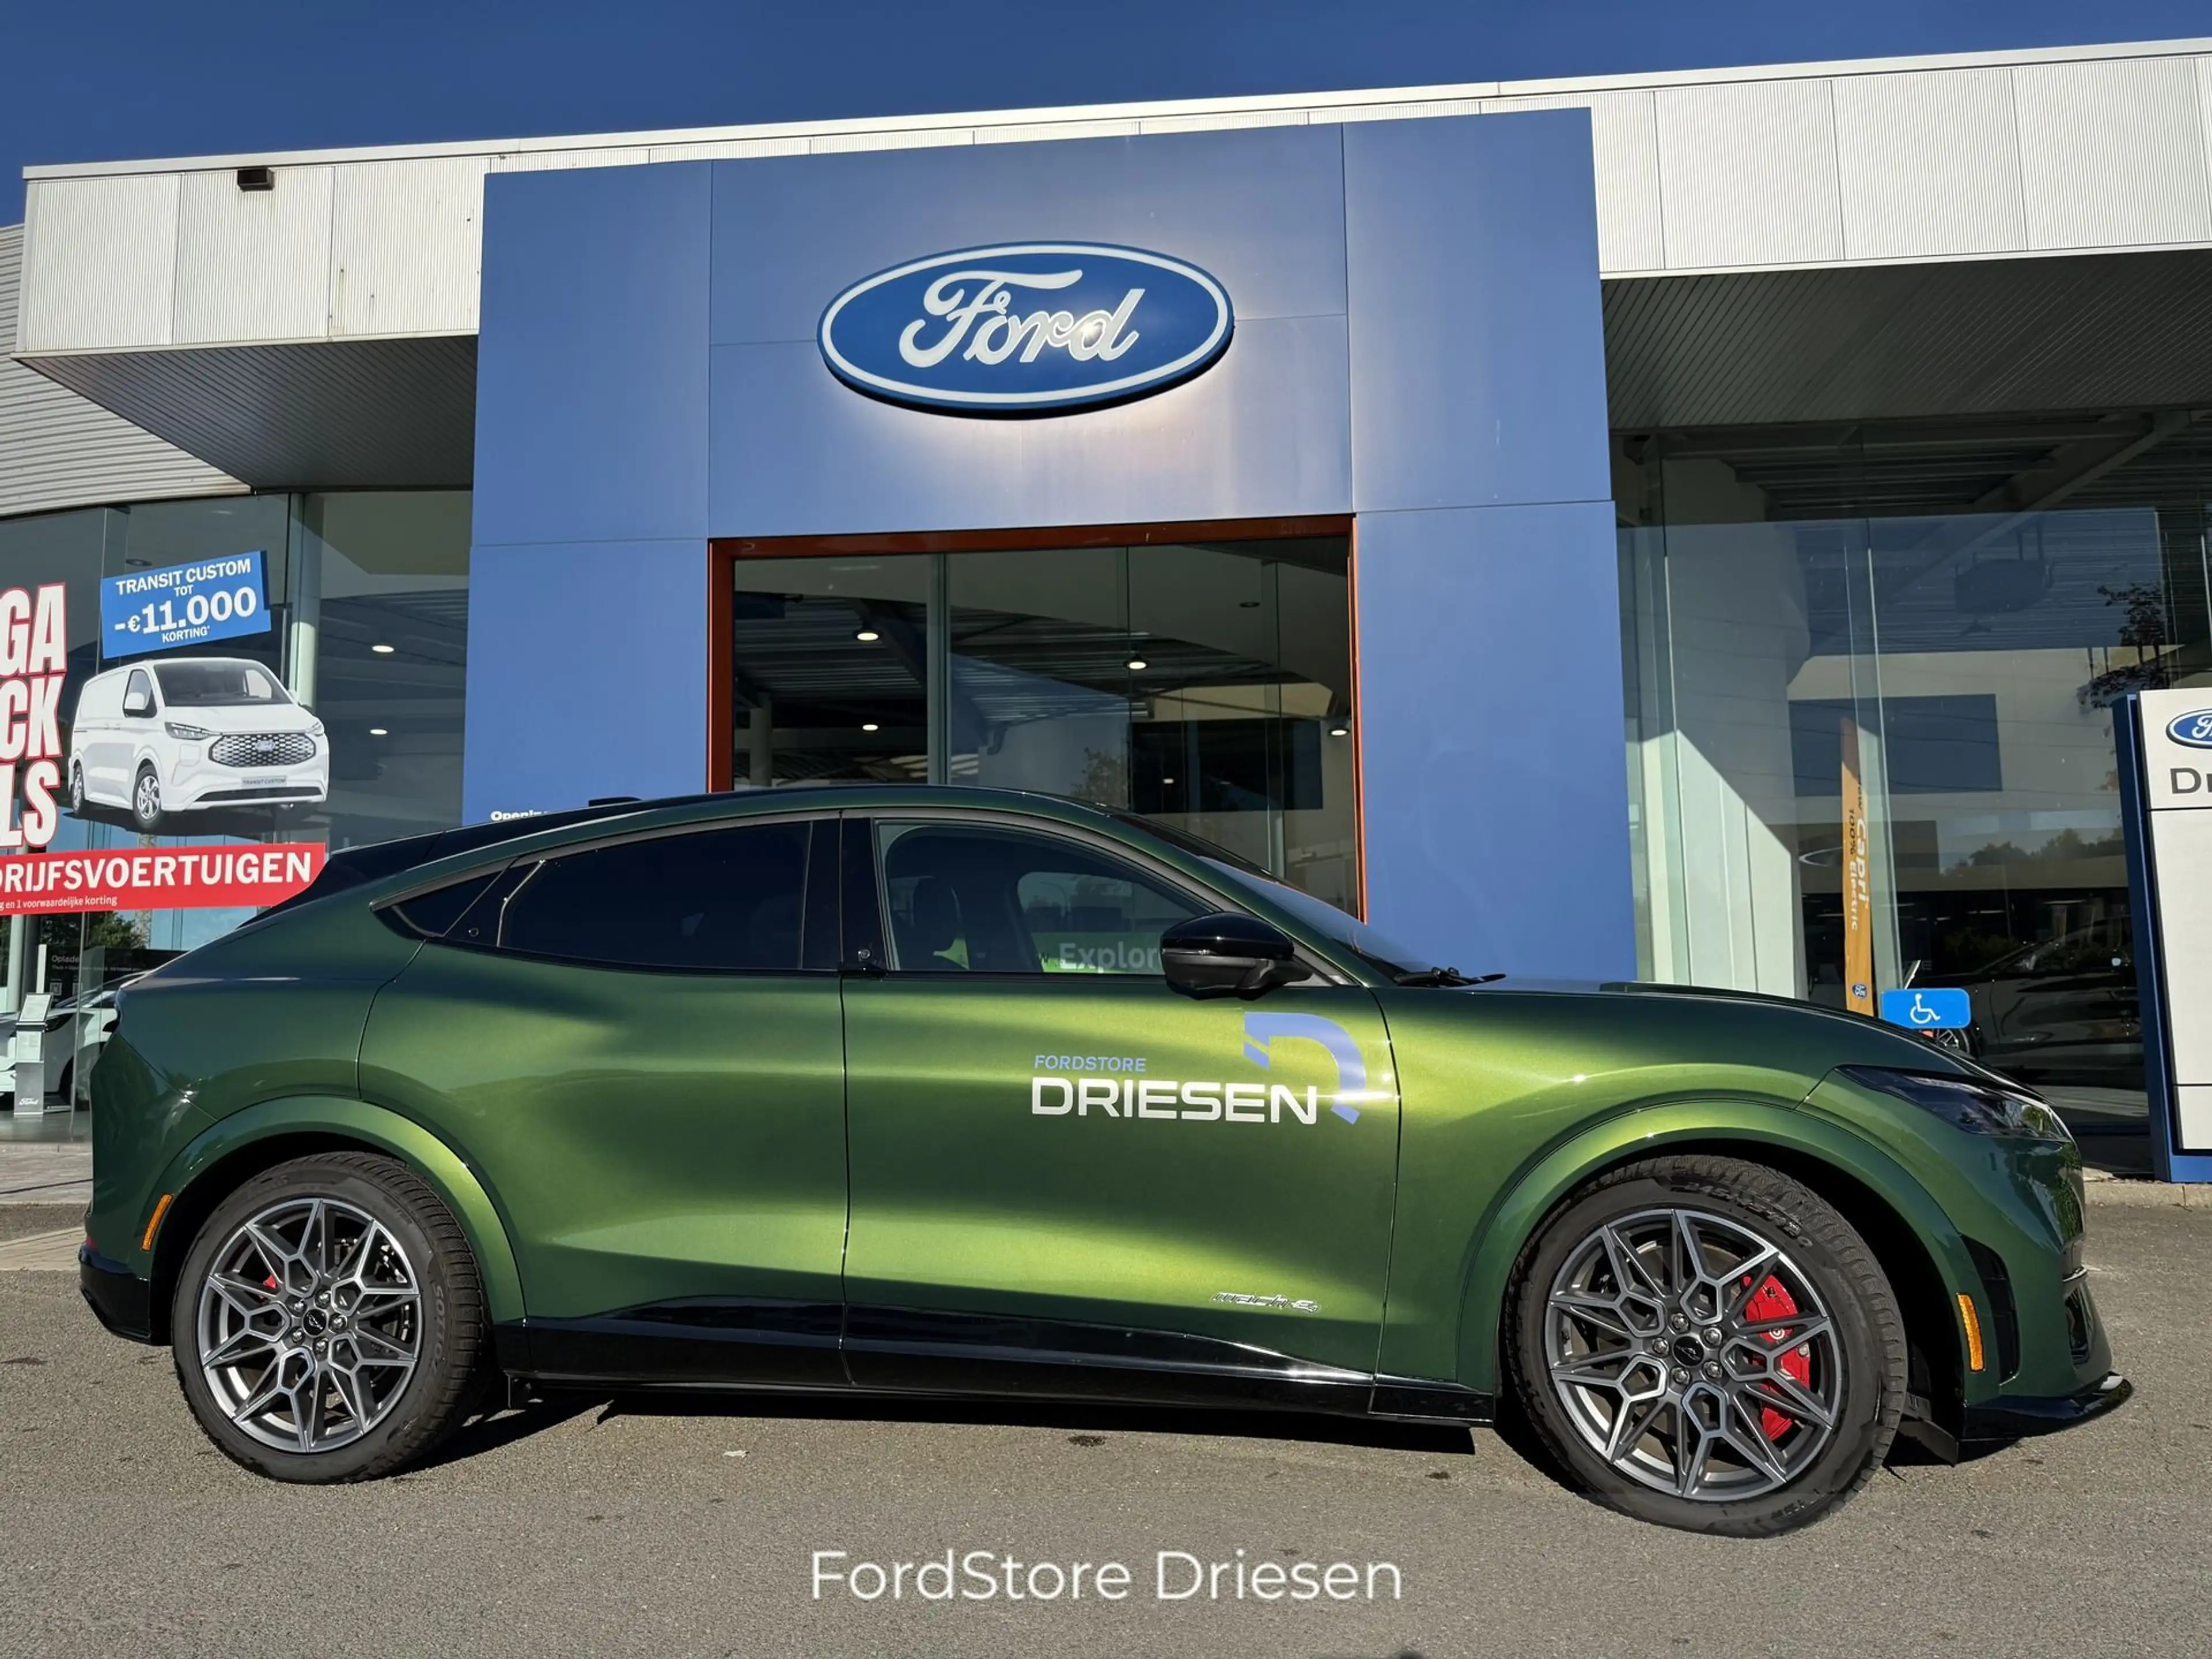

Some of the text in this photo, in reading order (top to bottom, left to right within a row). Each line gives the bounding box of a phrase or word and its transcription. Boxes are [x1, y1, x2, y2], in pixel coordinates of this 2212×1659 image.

[899, 269, 1145, 368] Ford
[116, 558, 251, 596] TRANSIT CUSTOM
[173, 585, 194, 597] TOT
[115, 586, 257, 634] -€11.000
[1857, 818, 1870, 902] Capri
[16, 900, 22, 908] 1
[23, 896, 84, 908] voorwaardelijke
[84, 894, 118, 906] korting
[1034, 1055, 1147, 1073] FORDSTORE
[1032, 1077, 1317, 1124] DRIESEN
